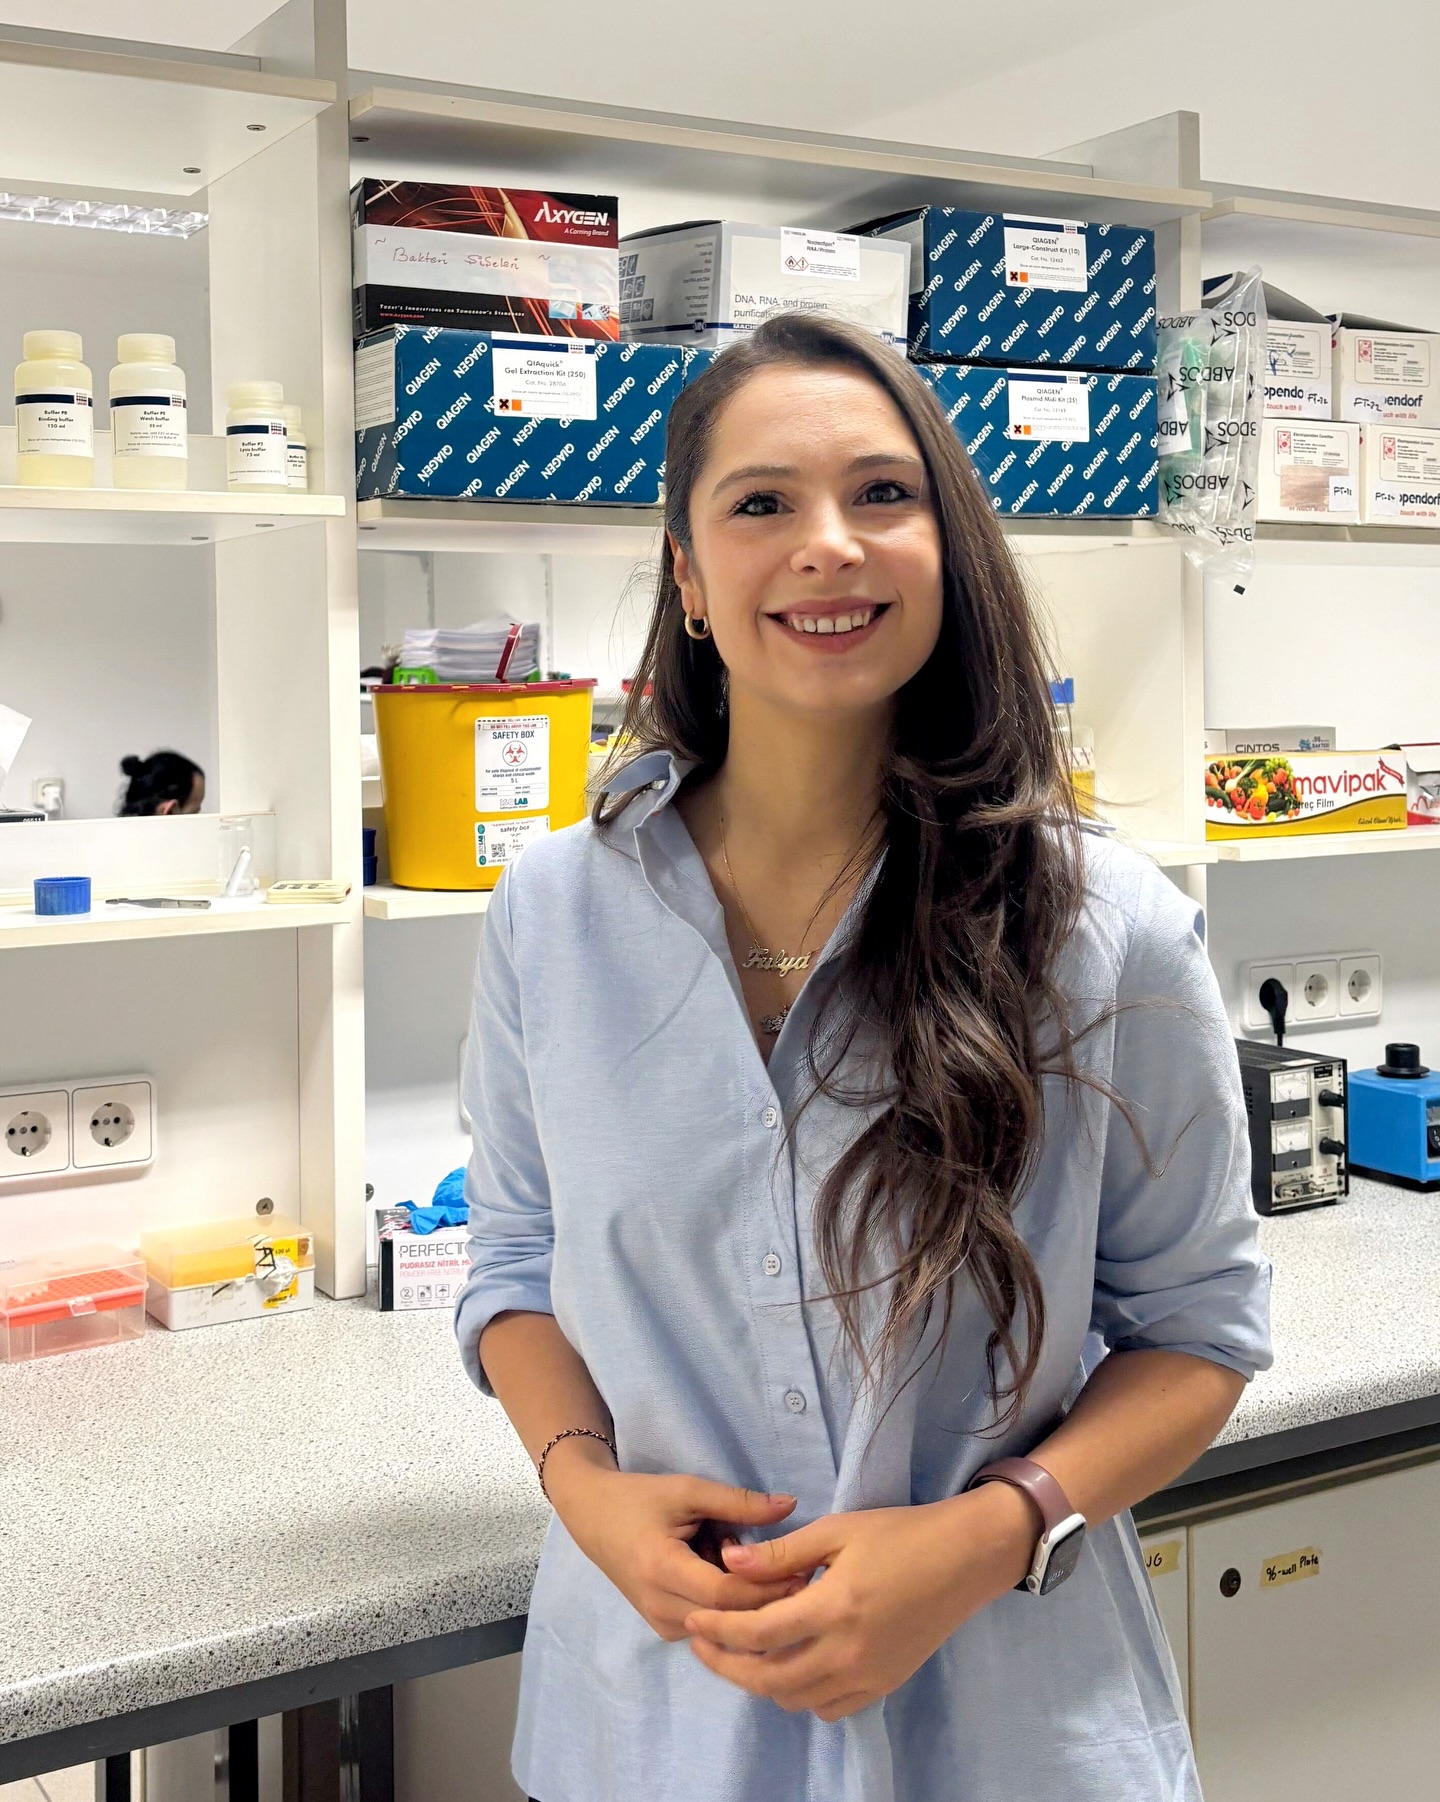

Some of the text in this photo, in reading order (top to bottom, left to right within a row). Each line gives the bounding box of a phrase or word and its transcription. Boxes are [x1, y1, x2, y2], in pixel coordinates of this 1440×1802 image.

[570, 229, 591, 237] Corning
[929, 229, 958, 261] QIAGEN
[967, 216, 994, 247] QIAGEN
[393, 247, 448, 265] Bakteri
[1087, 248, 1112, 279] QIAGEN
[1122, 235, 1146, 265] QIAGEN
[954, 259, 982, 292] QIAGEN
[782, 299, 798, 308] and
[800, 300, 828, 309] protein
[918, 274, 943, 310] QIAGEN
[977, 290, 1006, 322] QIAGEN
[1074, 291, 1100, 323] QIAGEN
[1108, 278, 1134, 309] QIAGEN
[939, 304, 968, 337] QIAGEN
[1001, 319, 1029, 352] QIAGEN
[1037, 305, 1064, 338] QIAGEN
[1095, 320, 1122, 352] QIAGEN
[1130, 307, 1155, 339] QIAGEN
[406, 357, 441, 395] QIAGEN
[453, 342, 488, 378] QIAGEN
[520, 368, 554, 376] Extraction
[1179, 367, 1235, 382] ABDOS
[647, 359, 680, 396] QIAGEN
[979, 377, 1006, 410] QIAGEN
[603, 376, 636, 412] QIAGEN
[1129, 389, 1154, 420] QIAGEN
[1385, 394, 1423, 407] endorf
[436, 392, 472, 430] QIAGEN
[630, 409, 662, 445] QIAGEN
[1095, 404, 1120, 436] QIAGEN
[391, 410, 423, 448] QIAGEN
[466, 426, 502, 464] QIAGEN
[587, 425, 620, 461] QIAGEN
[967, 421, 994, 455] QIAGEN
[371, 433, 387, 473] QIAGEN
[417, 444, 453, 482] QIAGEN
[541, 442, 575, 479] QIAGEN
[1083, 448, 1109, 480] QIAGEN
[1116, 432, 1142, 464] QIAGEN
[495, 460, 530, 497] QIAGEN
[614, 458, 647, 494] QIAGEN
[990, 451, 1017, 484] QIAGEN
[1047, 464, 1074, 496] QIAGEN
[1173, 475, 1229, 490] ABDOS
[1012, 480, 1039, 513] QIAGEN
[1104, 475, 1130, 508] QIAGEN
[493, 731, 519, 739] SAFETY
[1294, 769, 1387, 797] mavipak
[1316, 799, 1334, 808] Film
[1266, 1555, 1318, 1581] 96-well Plate
